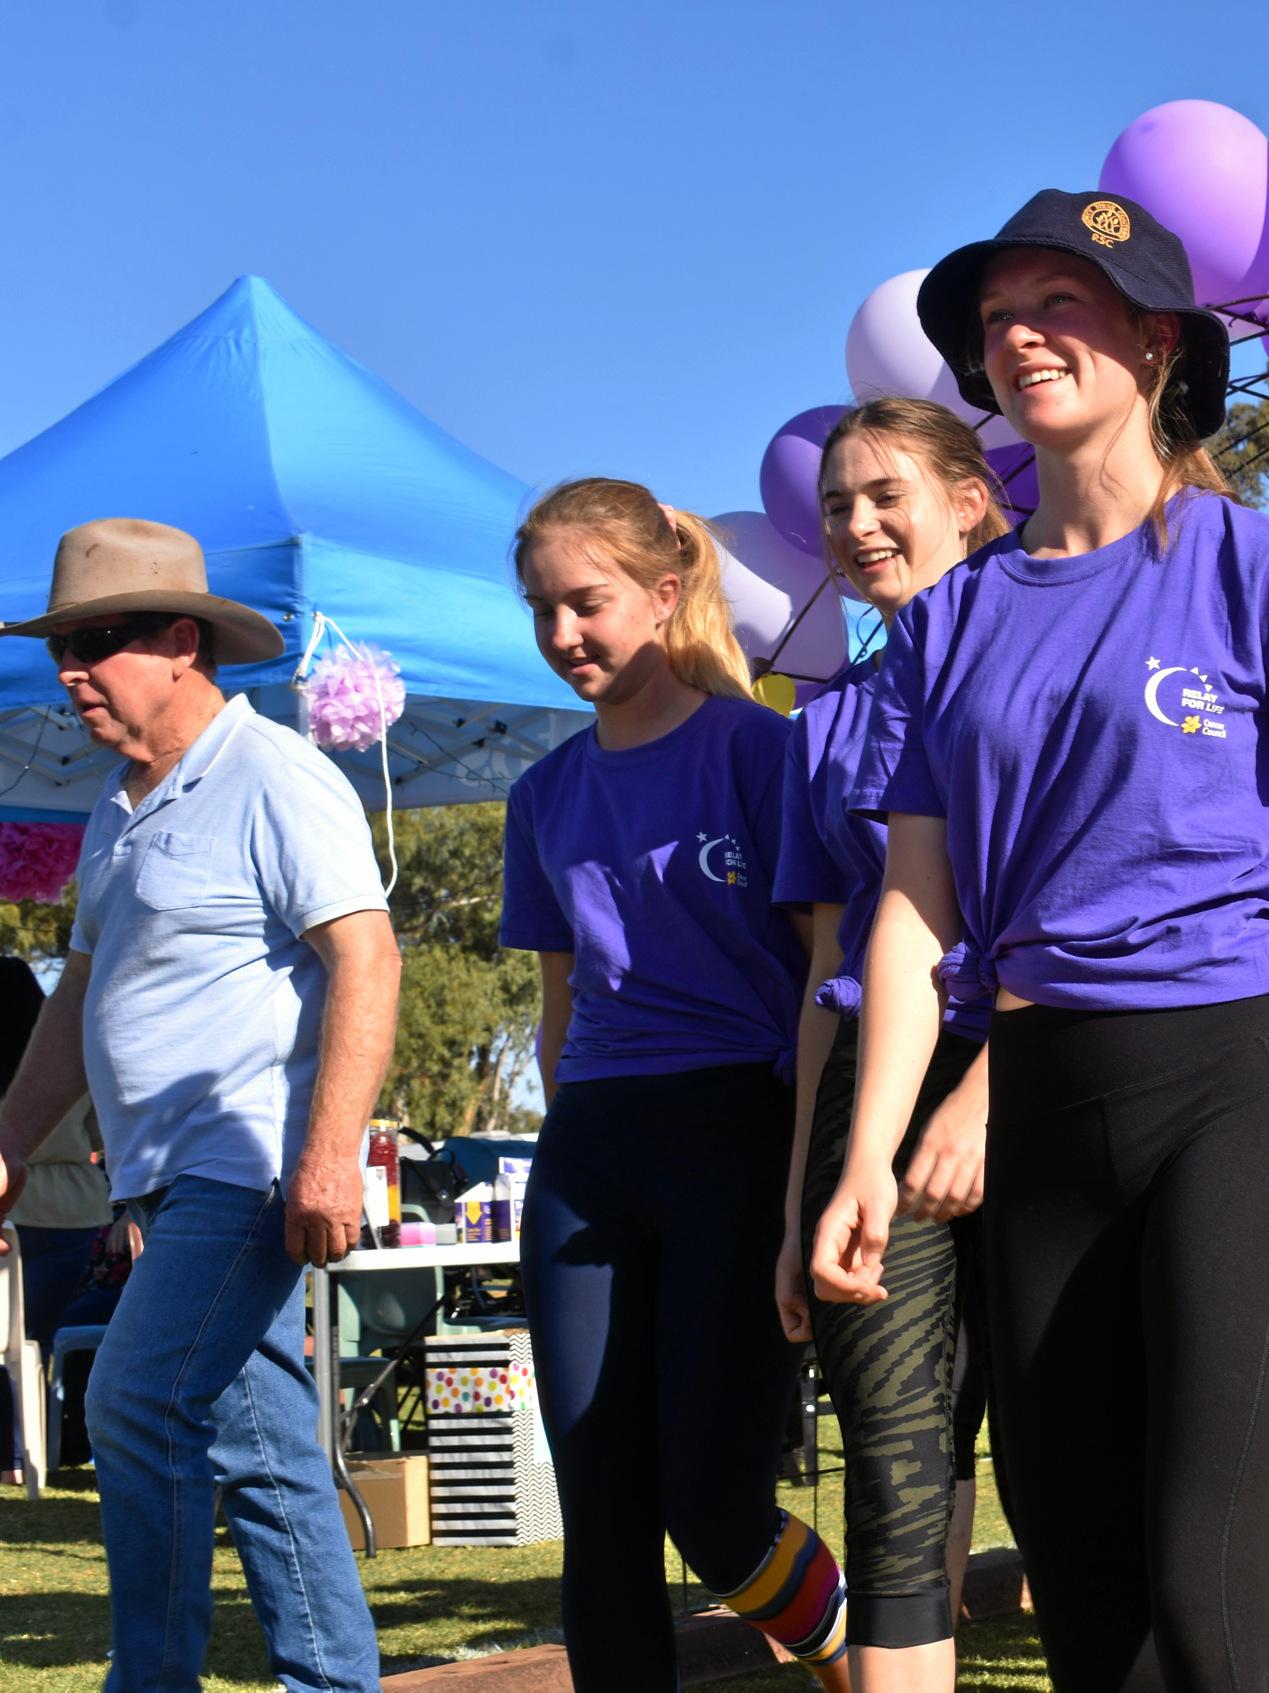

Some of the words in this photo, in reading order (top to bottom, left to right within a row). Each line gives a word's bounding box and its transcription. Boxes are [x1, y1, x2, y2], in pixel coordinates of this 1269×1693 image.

[1182, 688, 1218, 703] RELAY
[1181, 698, 1205, 710] FOR
[1205, 702, 1225, 714] LIFE
